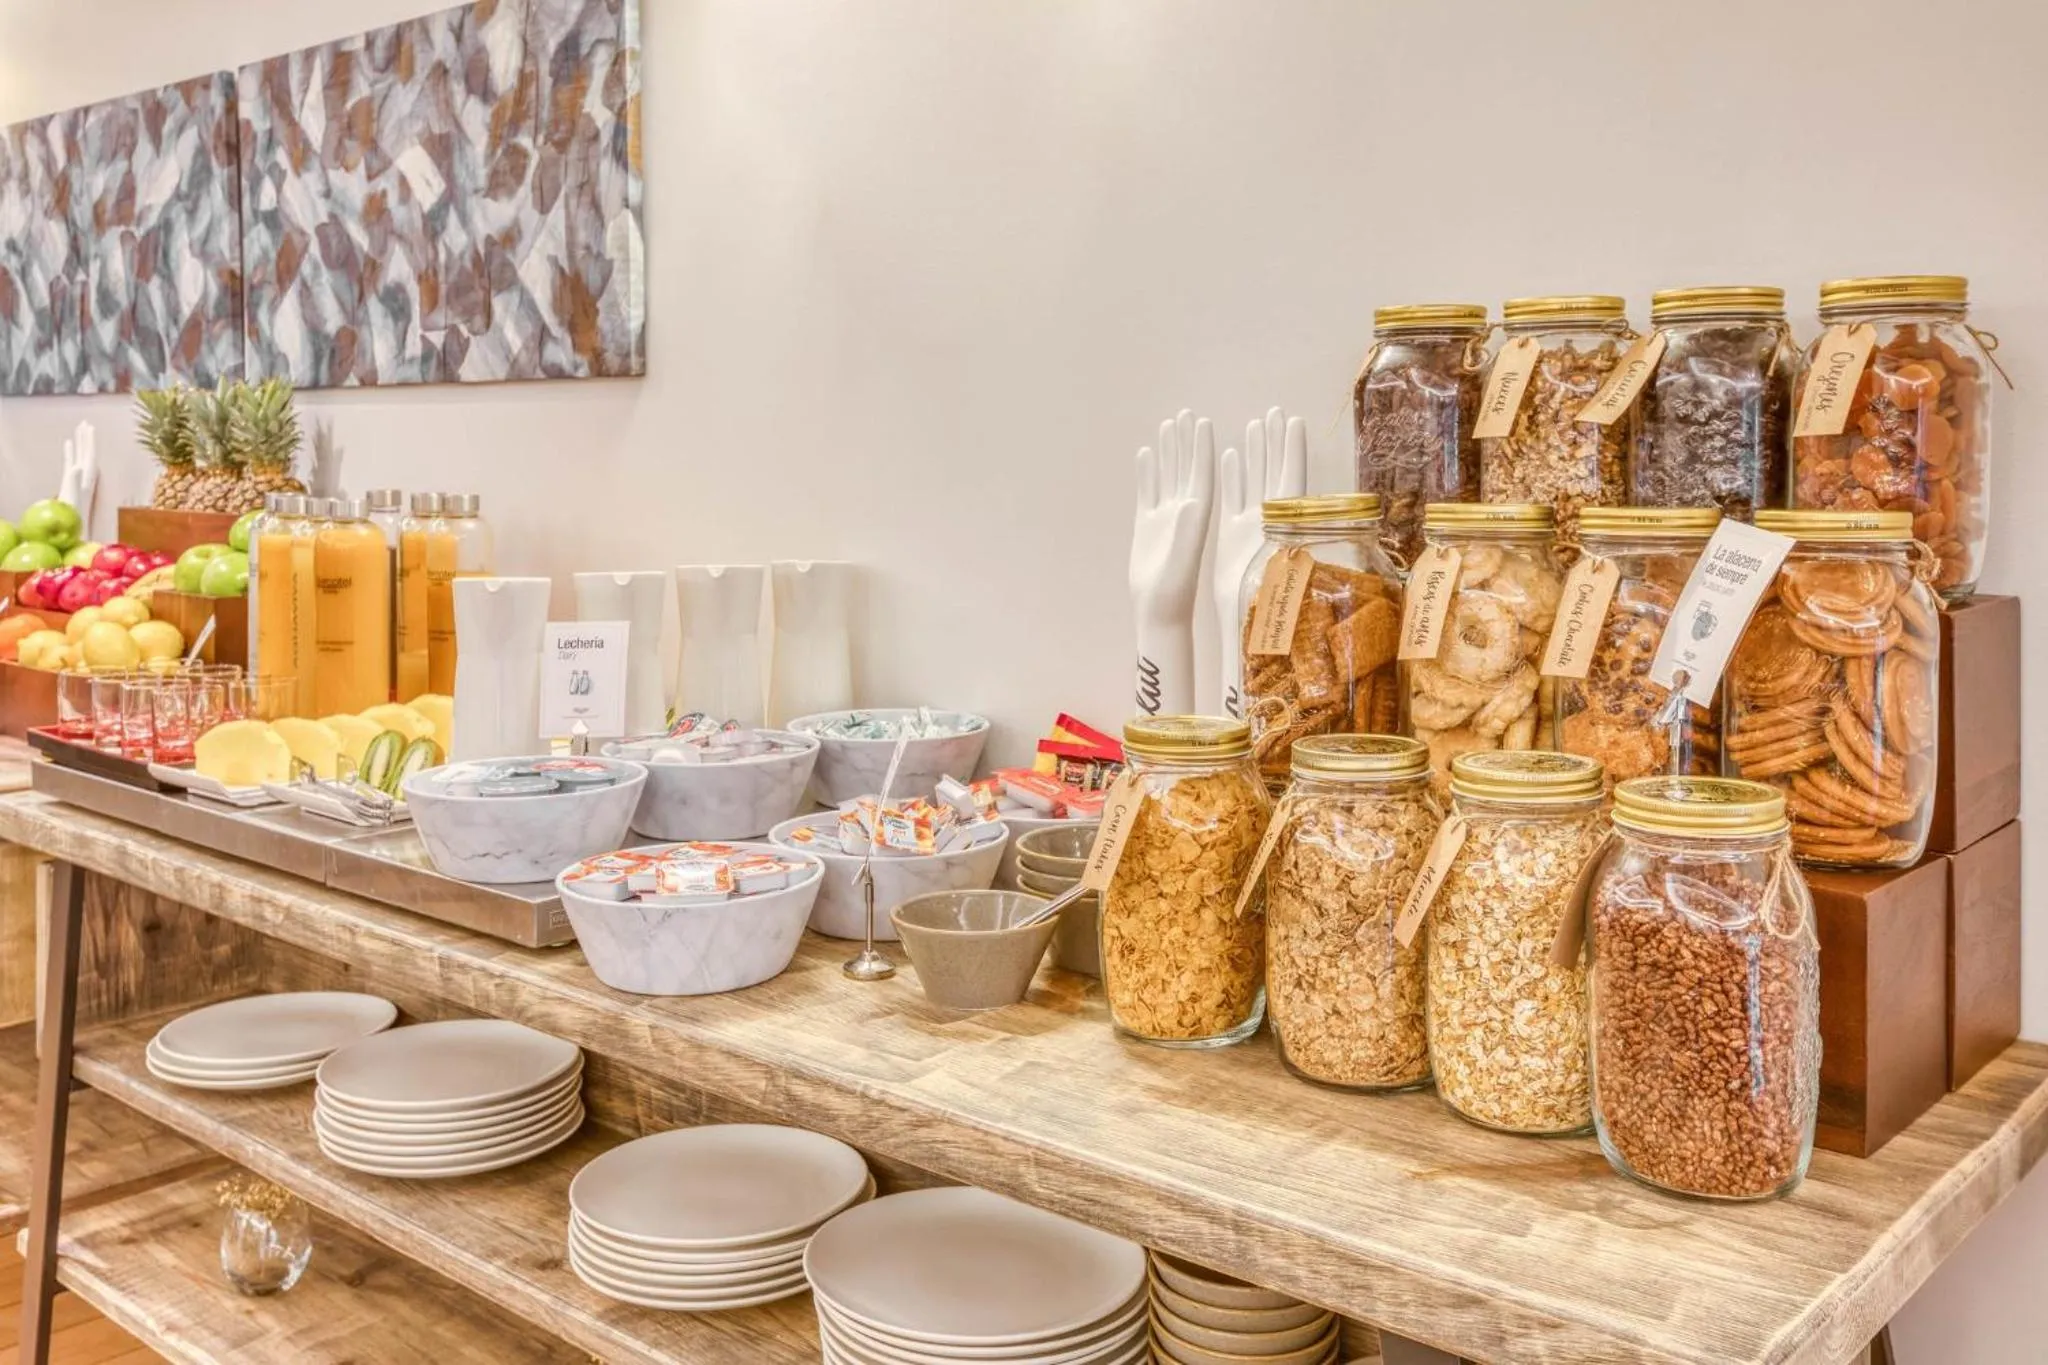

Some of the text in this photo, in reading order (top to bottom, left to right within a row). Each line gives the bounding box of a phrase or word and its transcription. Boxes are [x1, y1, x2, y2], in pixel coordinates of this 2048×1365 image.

[1705, 561, 1716, 575] de
[1712, 544, 1763, 573] La alacena
